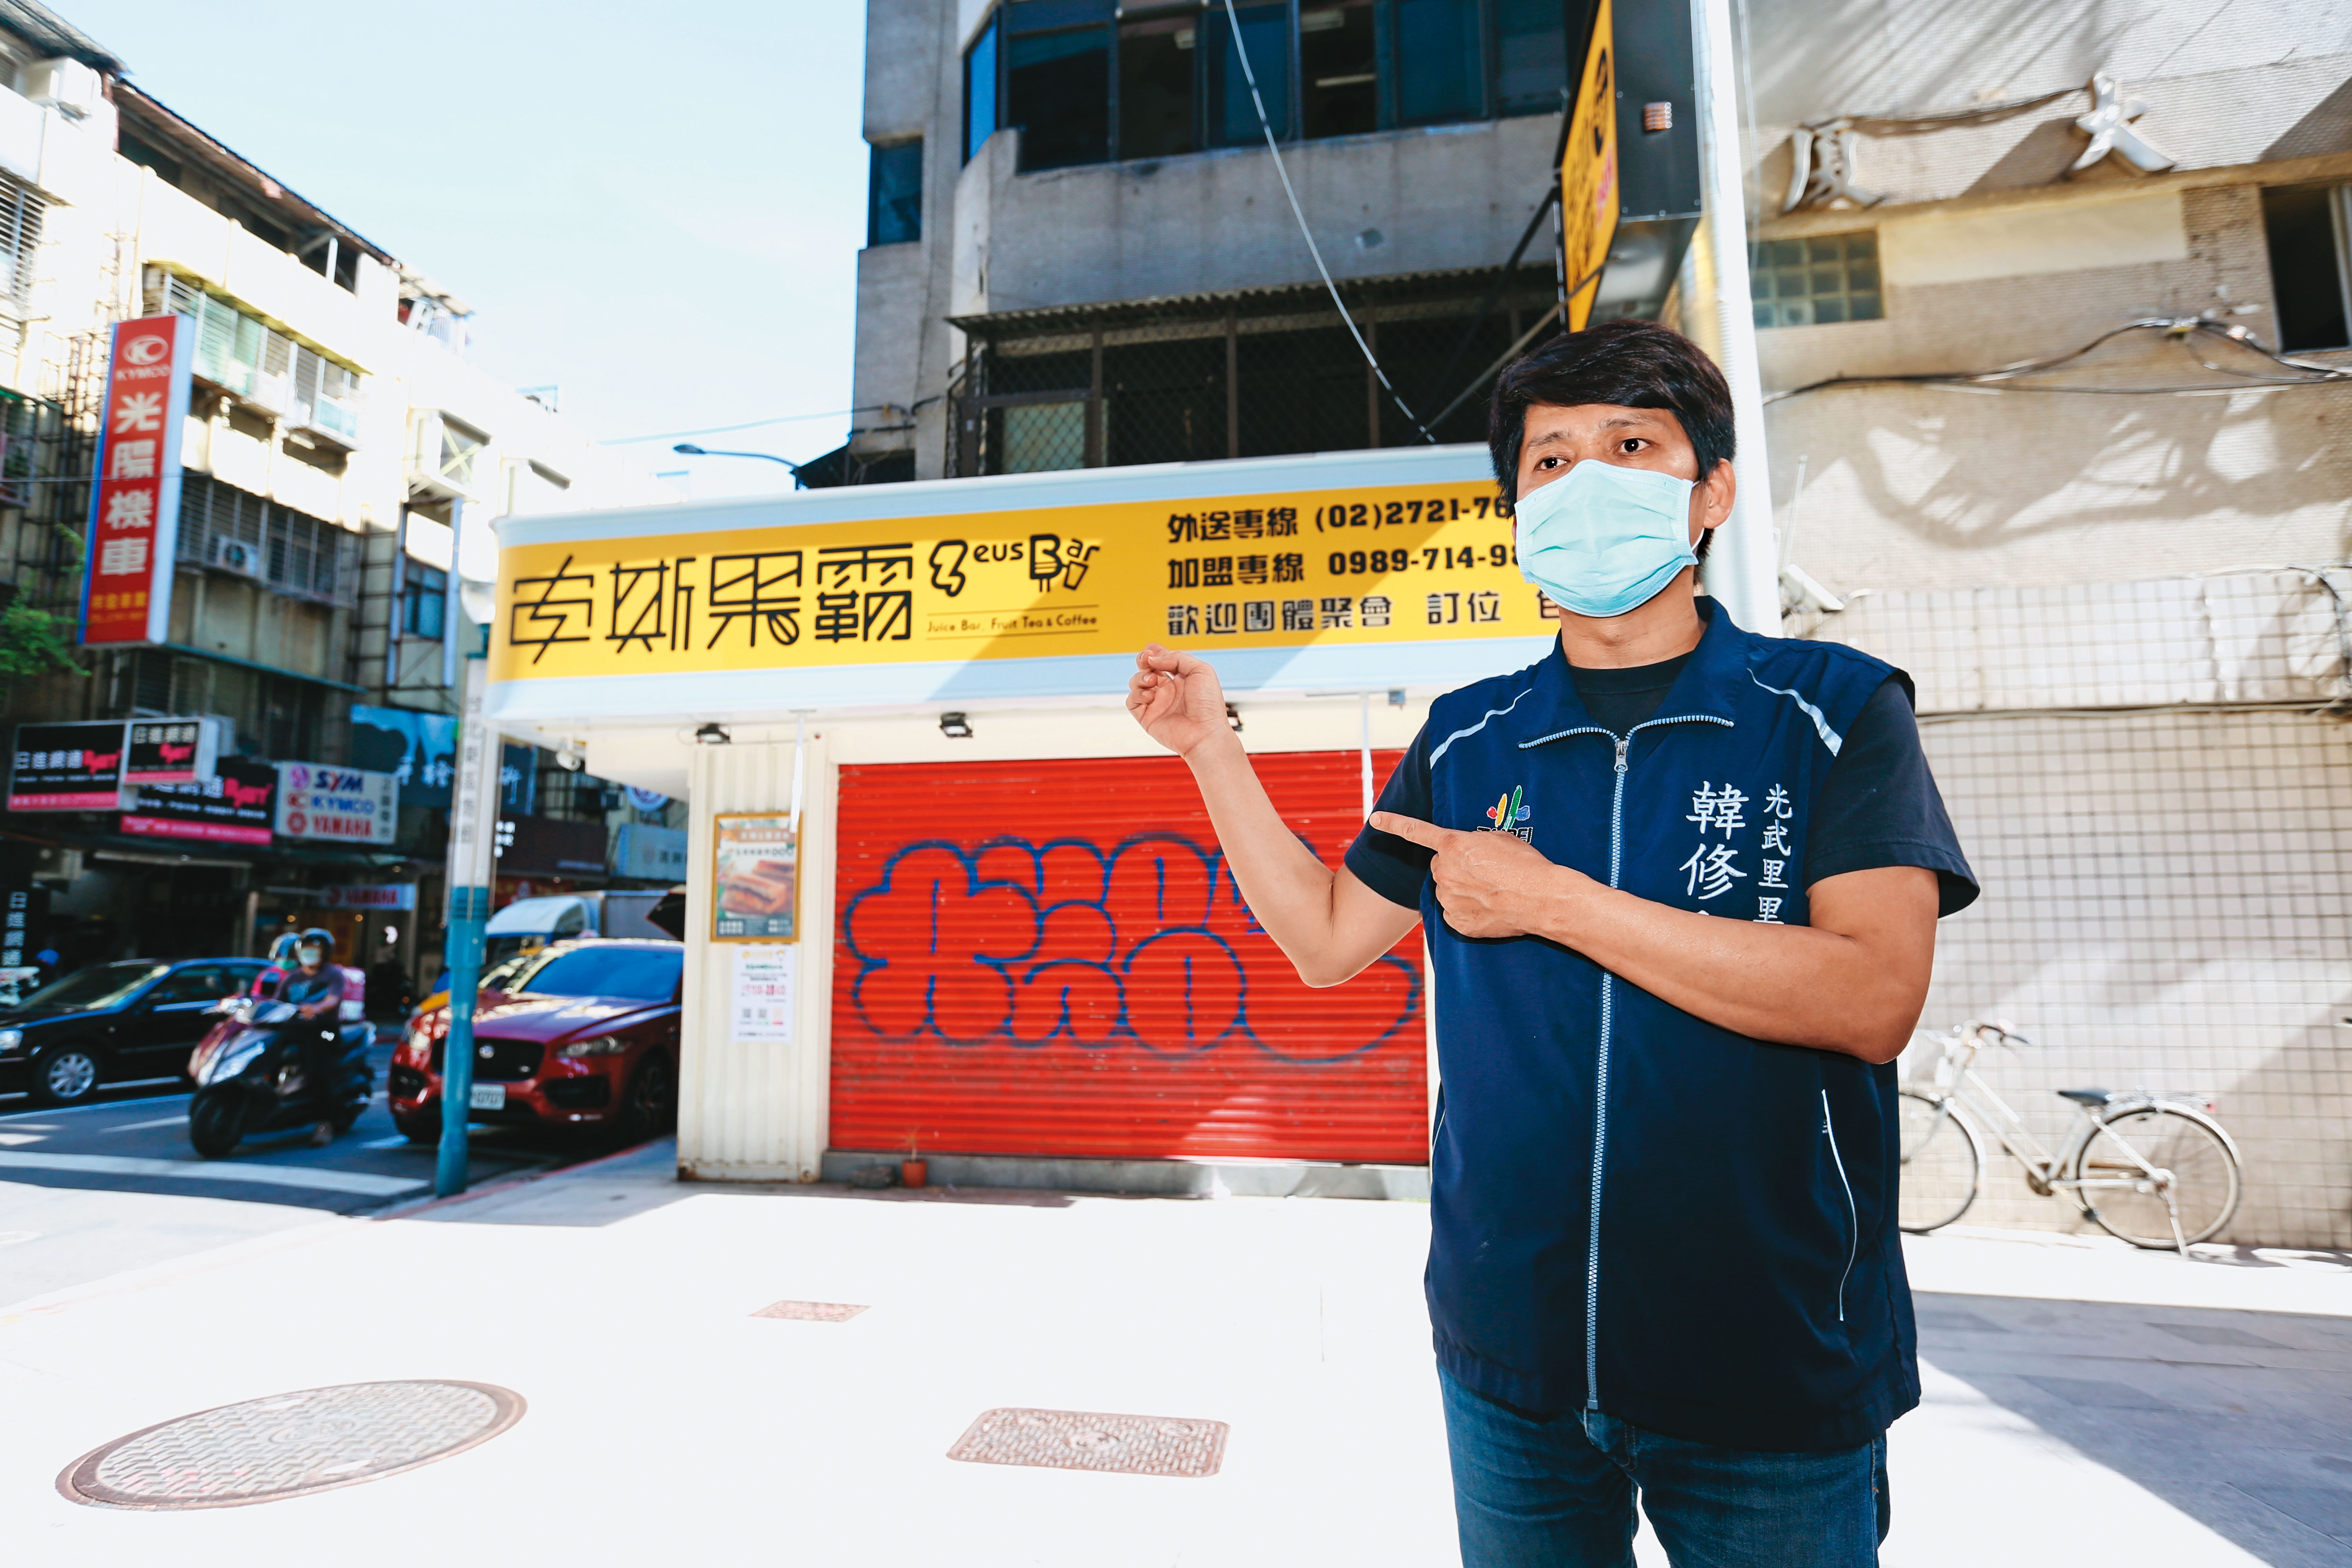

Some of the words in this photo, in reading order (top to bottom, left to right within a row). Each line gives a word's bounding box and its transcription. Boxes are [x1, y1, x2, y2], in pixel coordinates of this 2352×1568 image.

[116, 363, 172, 381] KYMCO
[100, 392, 163, 576] 光陽機車
[1167, 507, 1298, 543] 外送專線
[1029, 533, 1100, 588] Bar
[1168, 552, 1304, 589] 加盟專線
[1328, 544, 1518, 576] 0989-714-9
[927, 621, 956, 633] Juice
[991, 617, 1018, 630] Fruit
[1056, 614, 1098, 626] Coffee
[1167, 597, 1392, 636] 歡迎團體聚會
[1427, 591, 1502, 625] 訂位
[314, 769, 364, 793] SYM
[310, 795, 376, 816] KYMCO
[312, 815, 372, 837] YAMAHA
[1679, 780, 1749, 915] 韓修
[1753, 783, 1793, 924] 光武里里
[346, 889, 398, 904] YAMAHA
